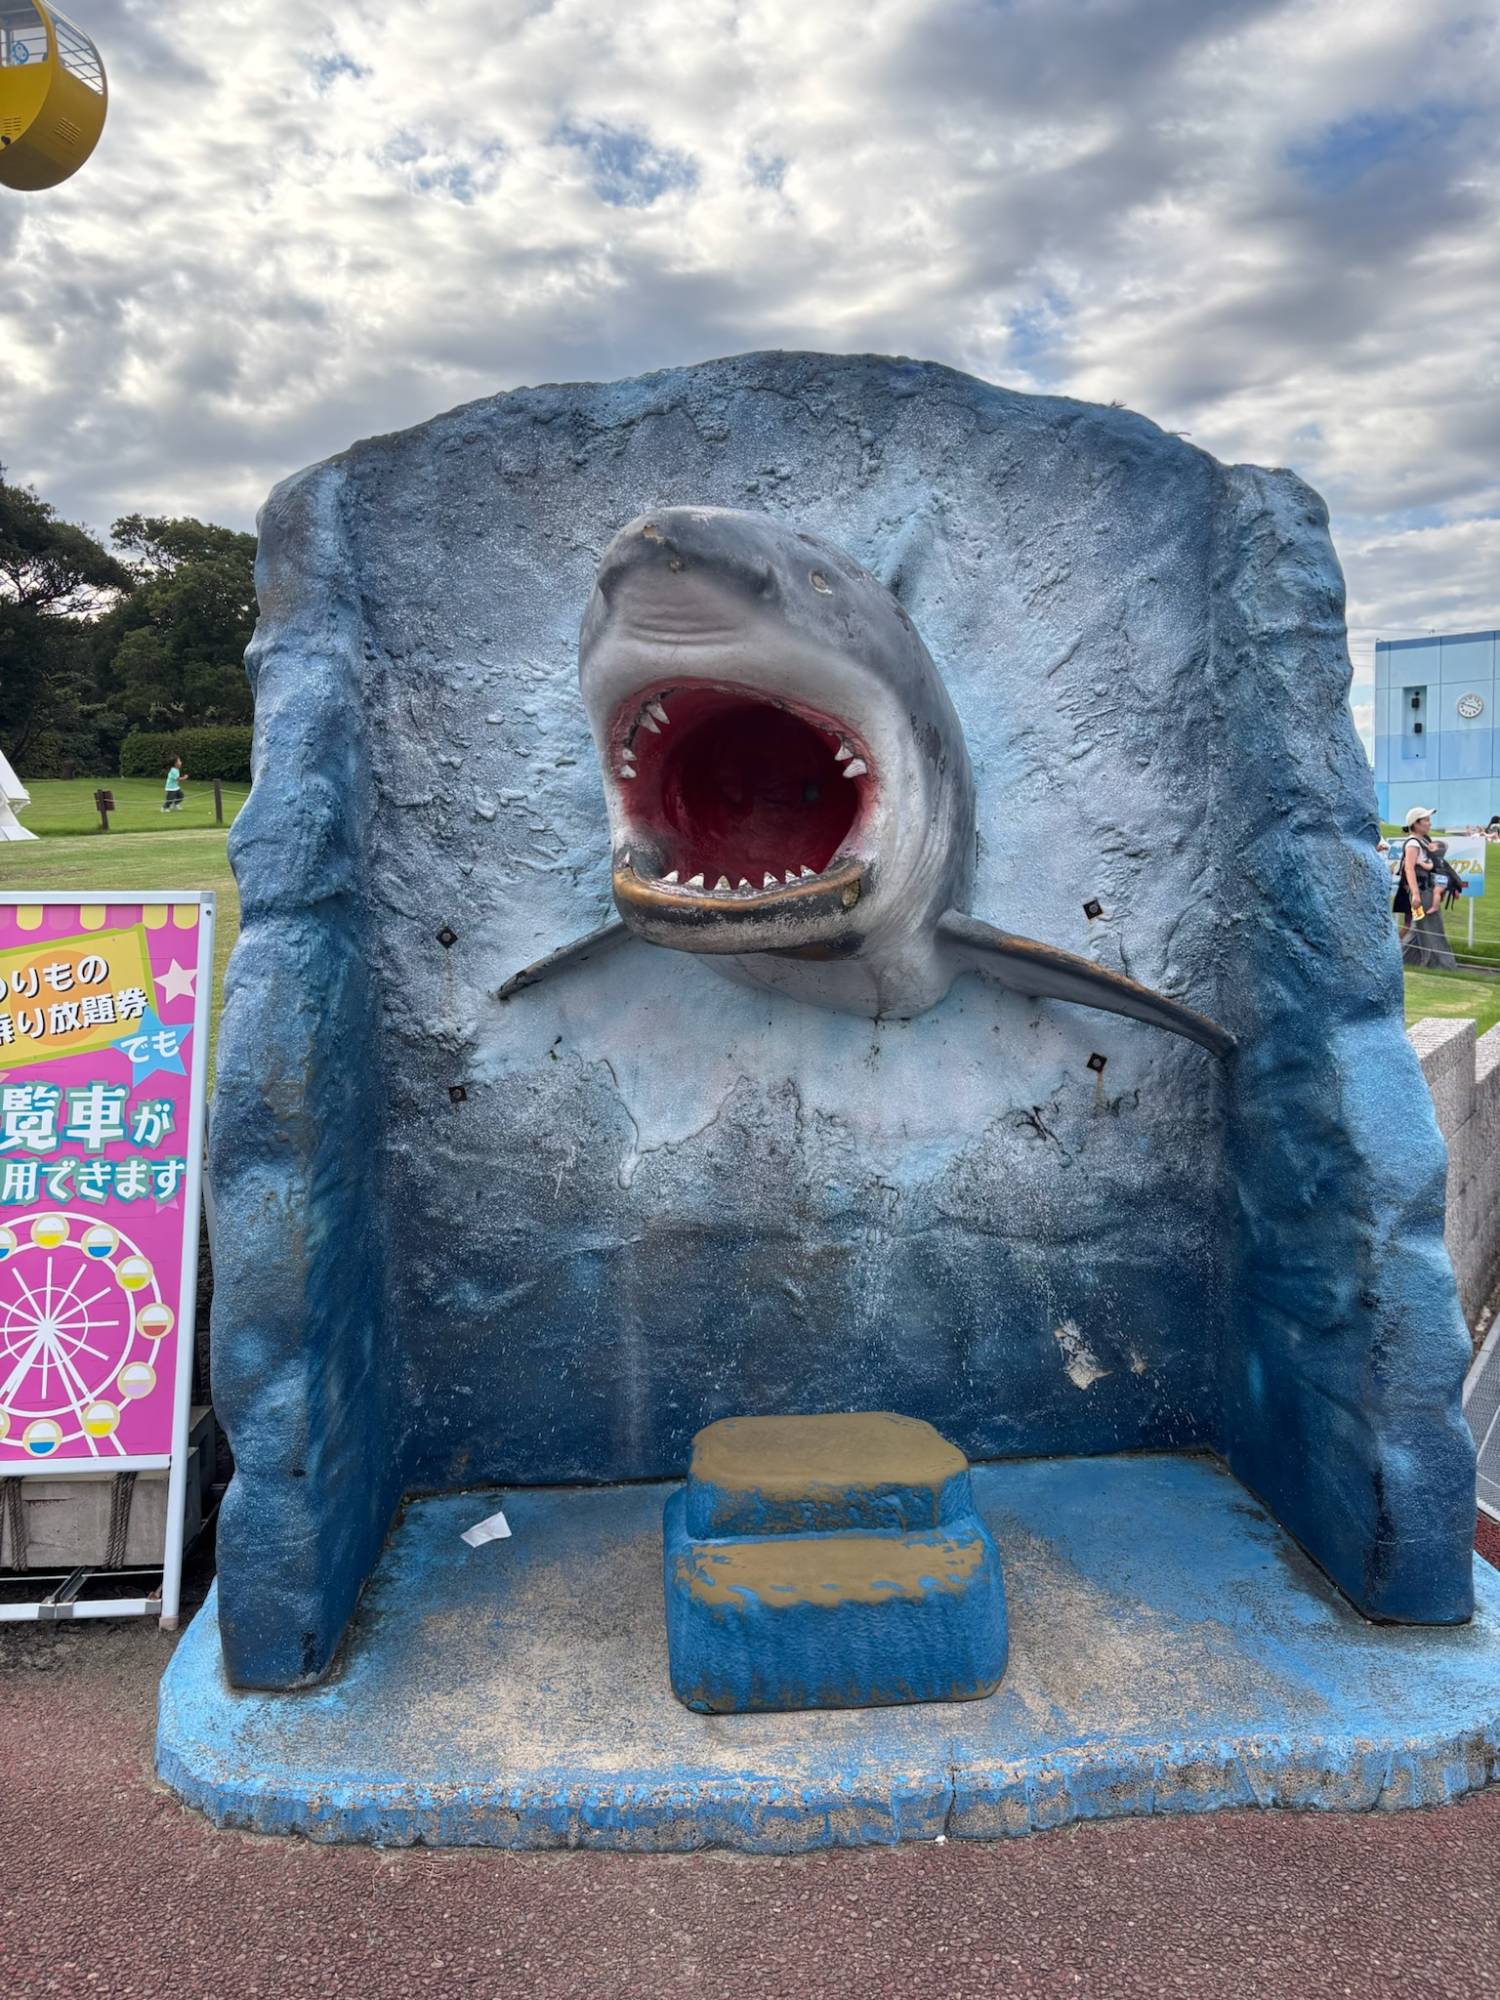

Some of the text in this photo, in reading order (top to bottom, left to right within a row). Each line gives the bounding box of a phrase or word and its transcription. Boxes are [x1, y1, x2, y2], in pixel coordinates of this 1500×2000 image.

[121, 1031, 179, 1063] でも
[0, 1085, 170, 1150] 覧車が
[2, 1160, 185, 1200] 用できます
